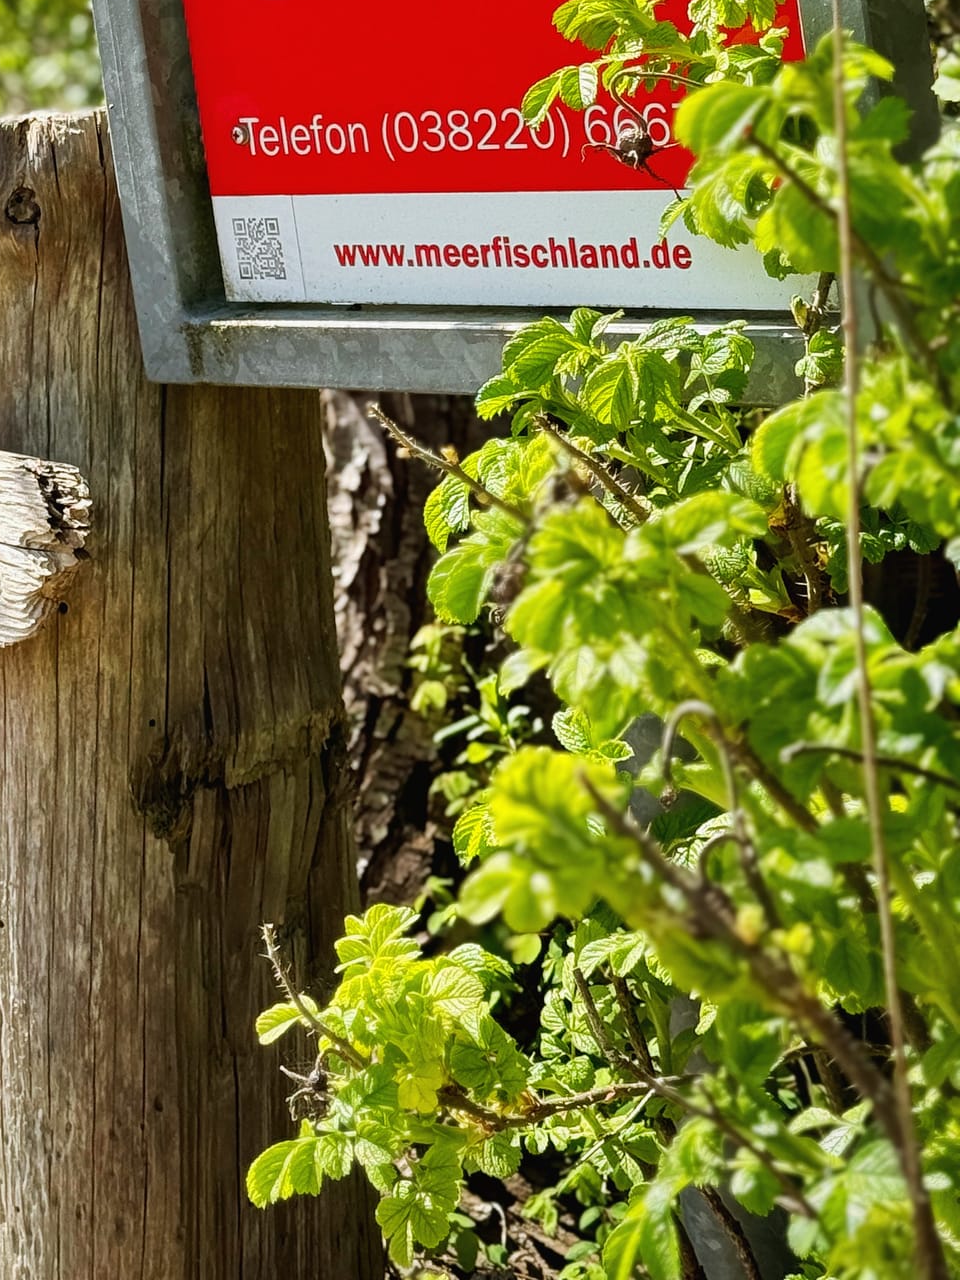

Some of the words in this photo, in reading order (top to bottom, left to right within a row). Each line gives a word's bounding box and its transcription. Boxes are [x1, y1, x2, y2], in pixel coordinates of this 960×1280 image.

[238, 114, 370, 157] Telefon
[382, 106, 572, 162] (038220)
[334, 236, 693, 269] www.meerfischland.de
